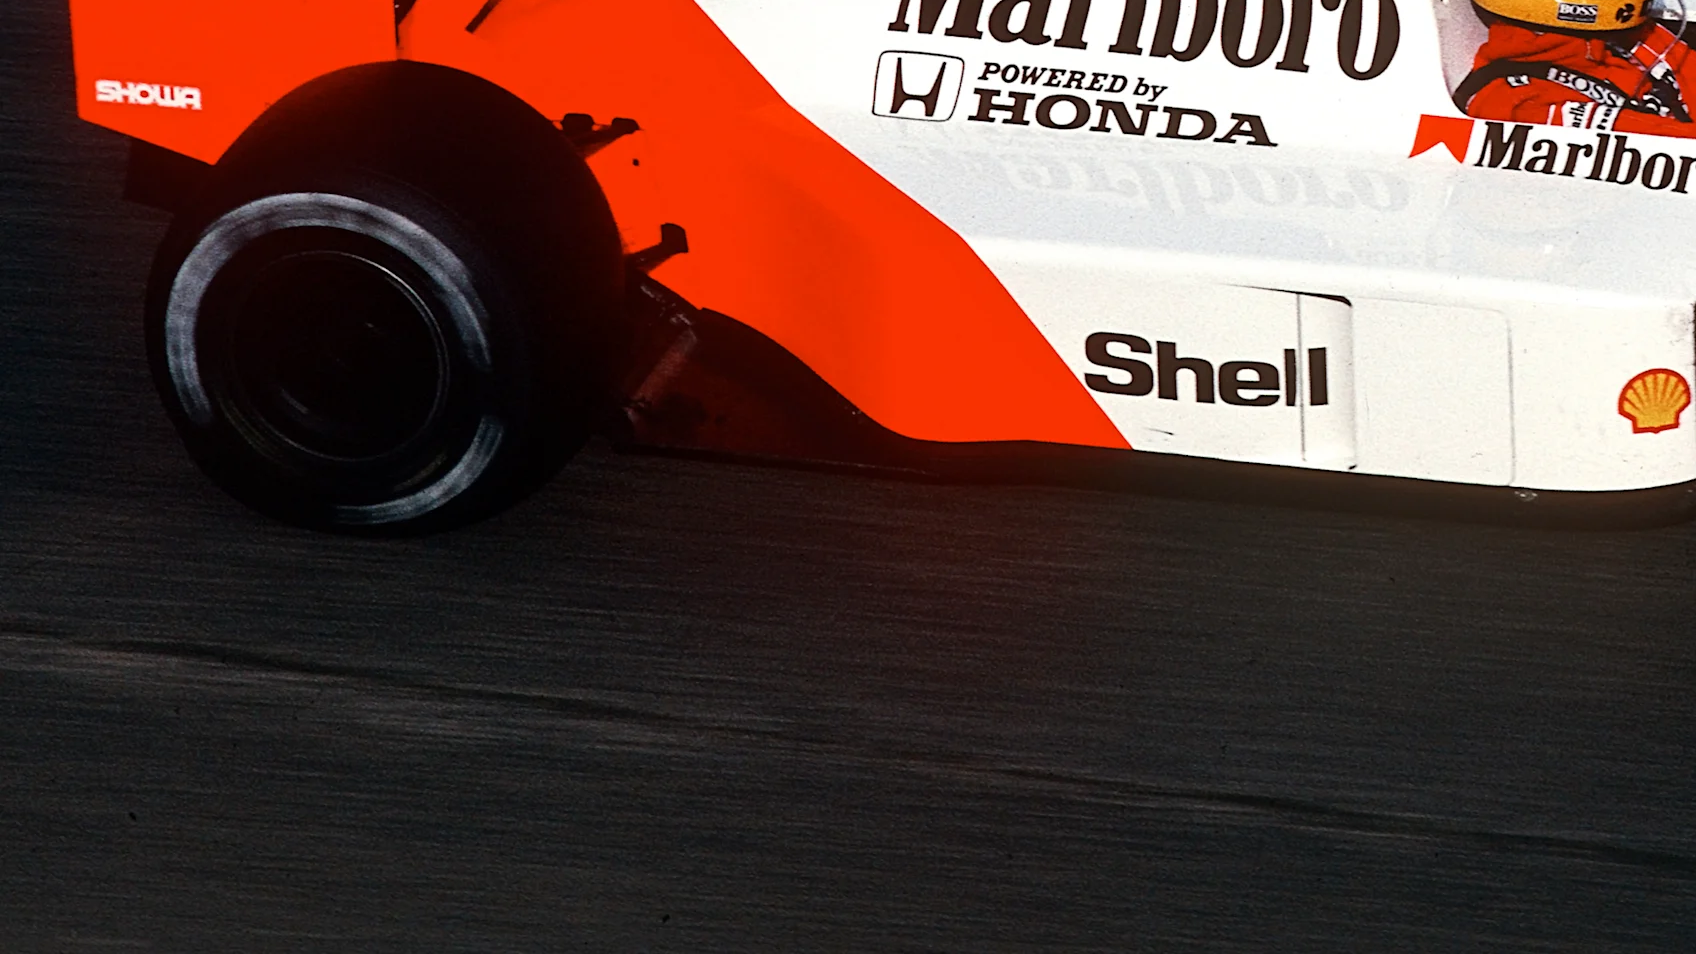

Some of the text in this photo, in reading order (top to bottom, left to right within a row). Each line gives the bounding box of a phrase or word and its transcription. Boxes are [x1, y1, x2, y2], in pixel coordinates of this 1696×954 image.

[1560, 3, 1598, 16] BOSS
[95, 79, 203, 111] SHOWA
[977, 61, 1168, 102] POWERED by
[1554, 69, 1621, 109] BOSS
[967, 87, 1279, 147] HONDA
[1084, 331, 1329, 407] Shell
